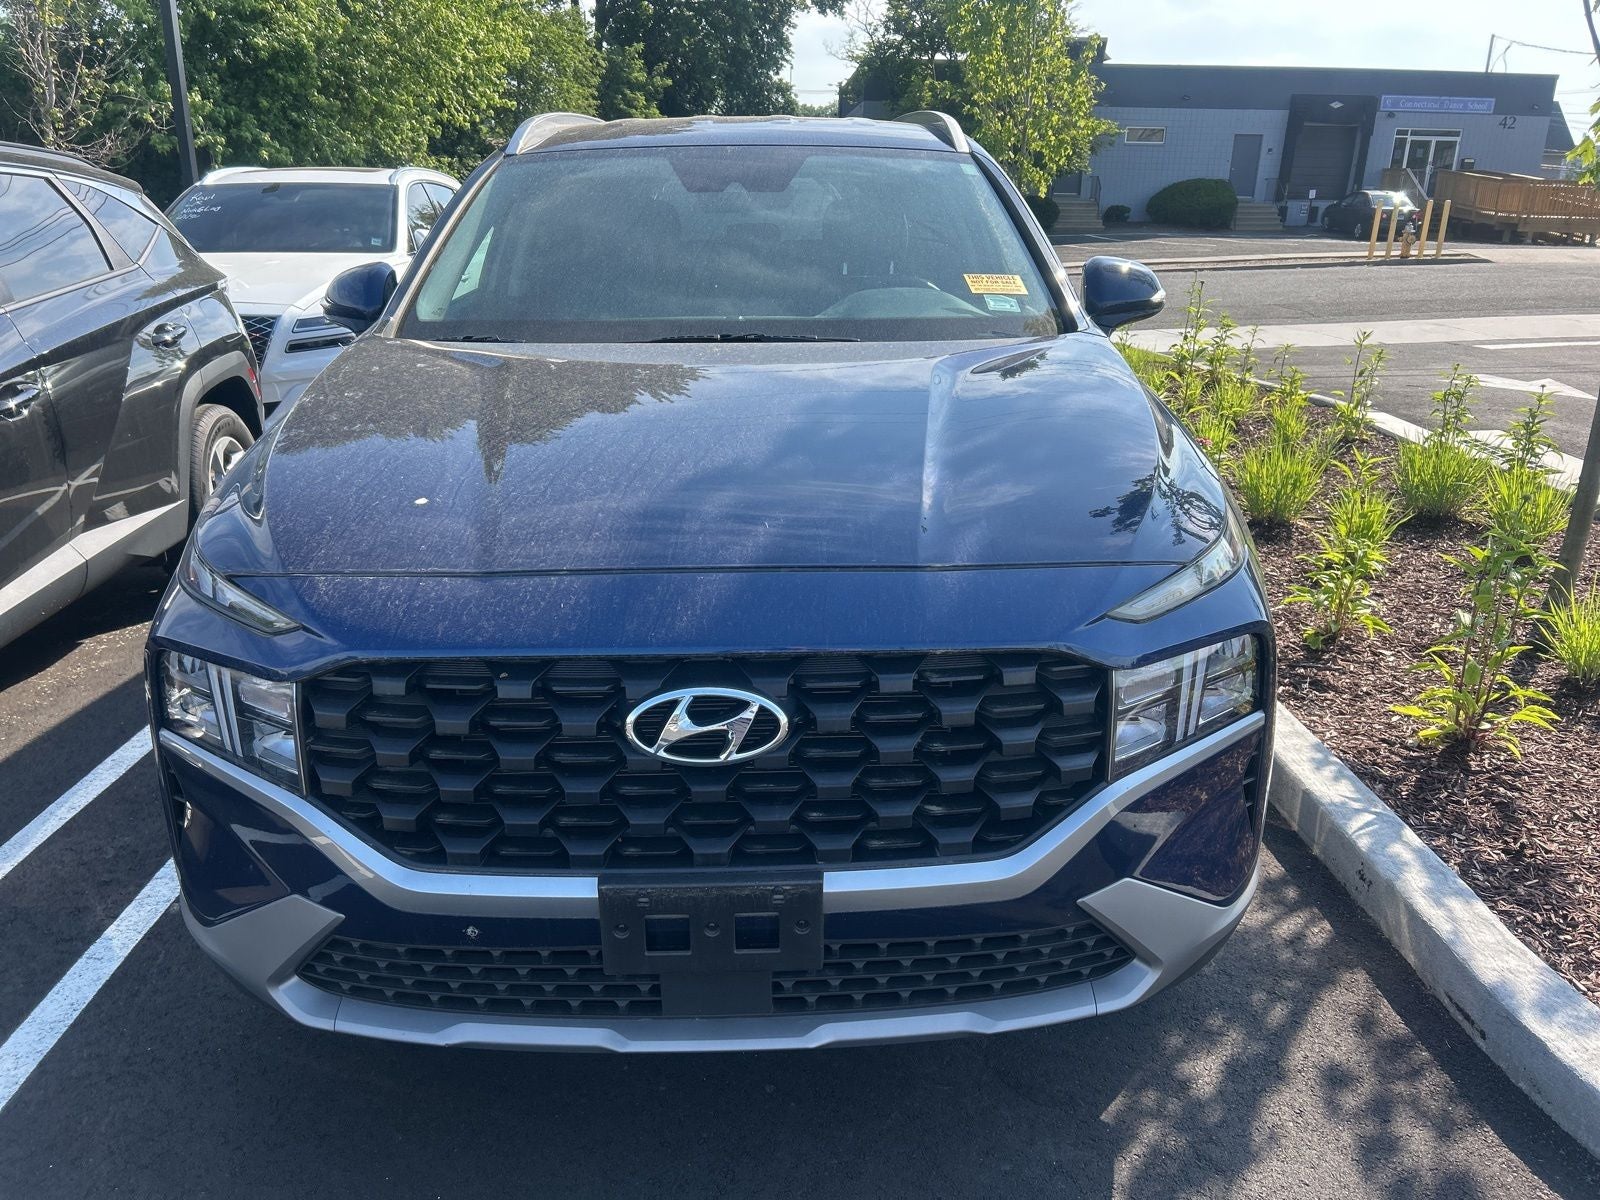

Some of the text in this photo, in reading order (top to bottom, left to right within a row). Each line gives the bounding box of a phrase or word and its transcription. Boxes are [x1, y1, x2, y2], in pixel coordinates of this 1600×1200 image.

[1400, 99, 1440, 109] Connecticut
[1443, 100, 1463, 109] Dance
[1468, 101, 1488, 110] School
[1499, 116, 1517, 129] 42
